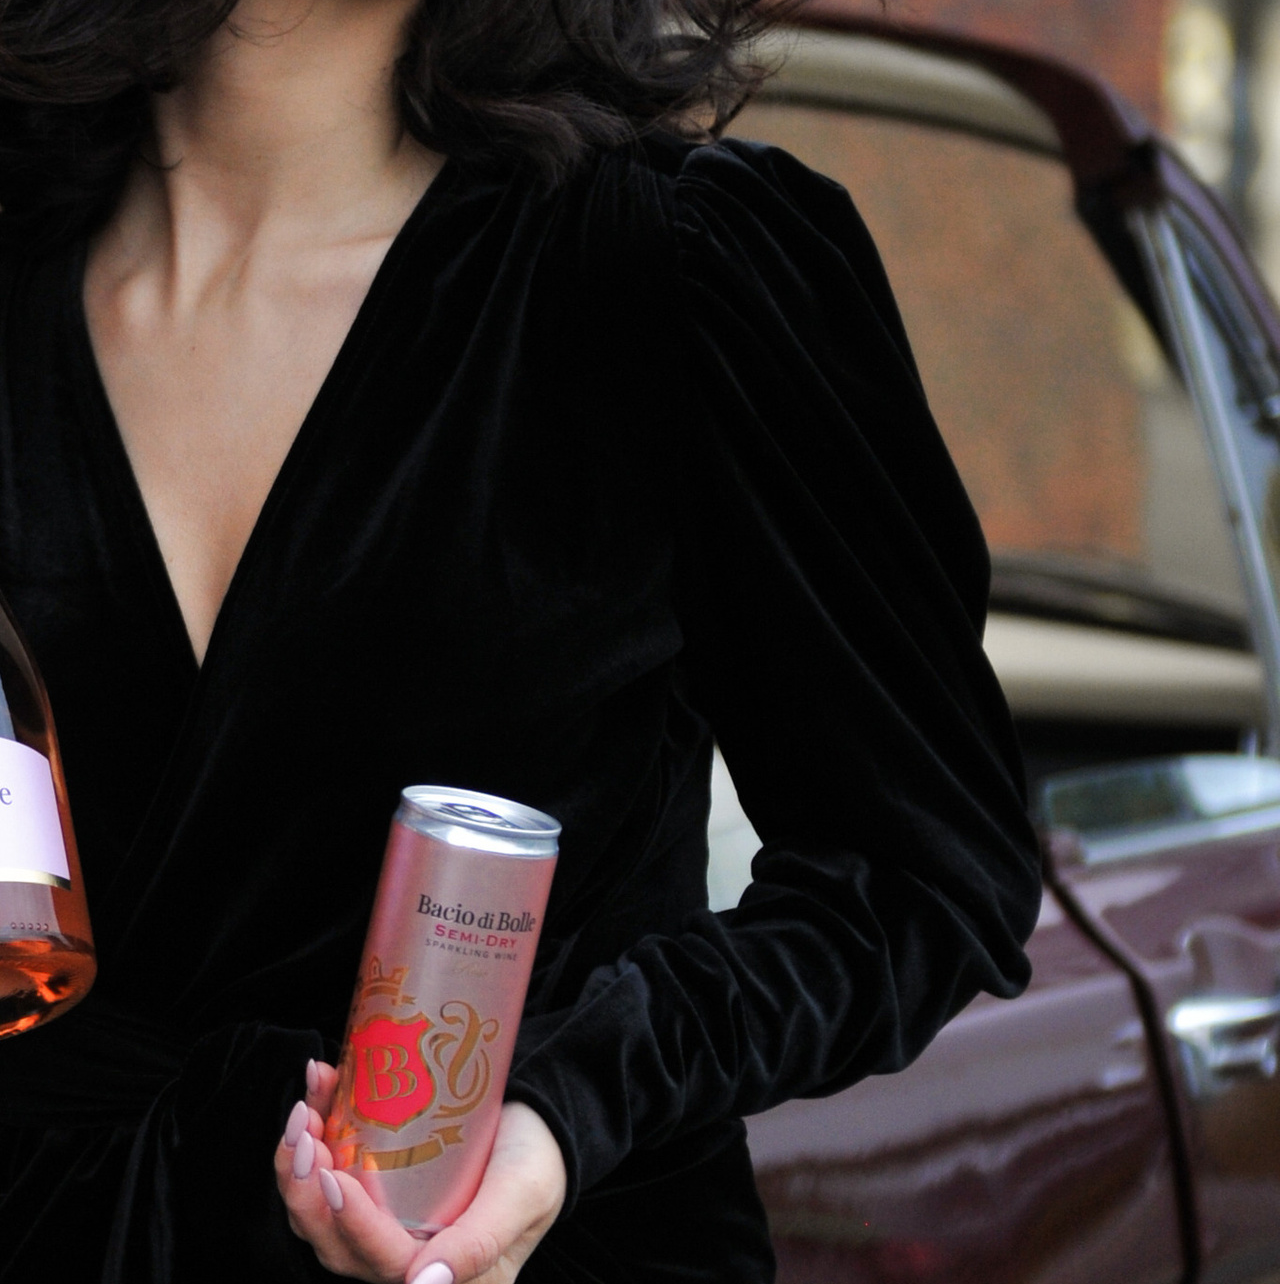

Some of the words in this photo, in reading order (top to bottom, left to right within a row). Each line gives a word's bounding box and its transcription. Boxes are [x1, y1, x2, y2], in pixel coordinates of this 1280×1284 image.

[416, 893, 475, 926] Bacio
[477, 912, 495, 930] di
[496, 911, 537, 933] Bolle
[434, 923, 518, 949] SEMI-DRY
[424, 938, 490, 959] SPARKLING
[494, 952, 518, 962] WINE
